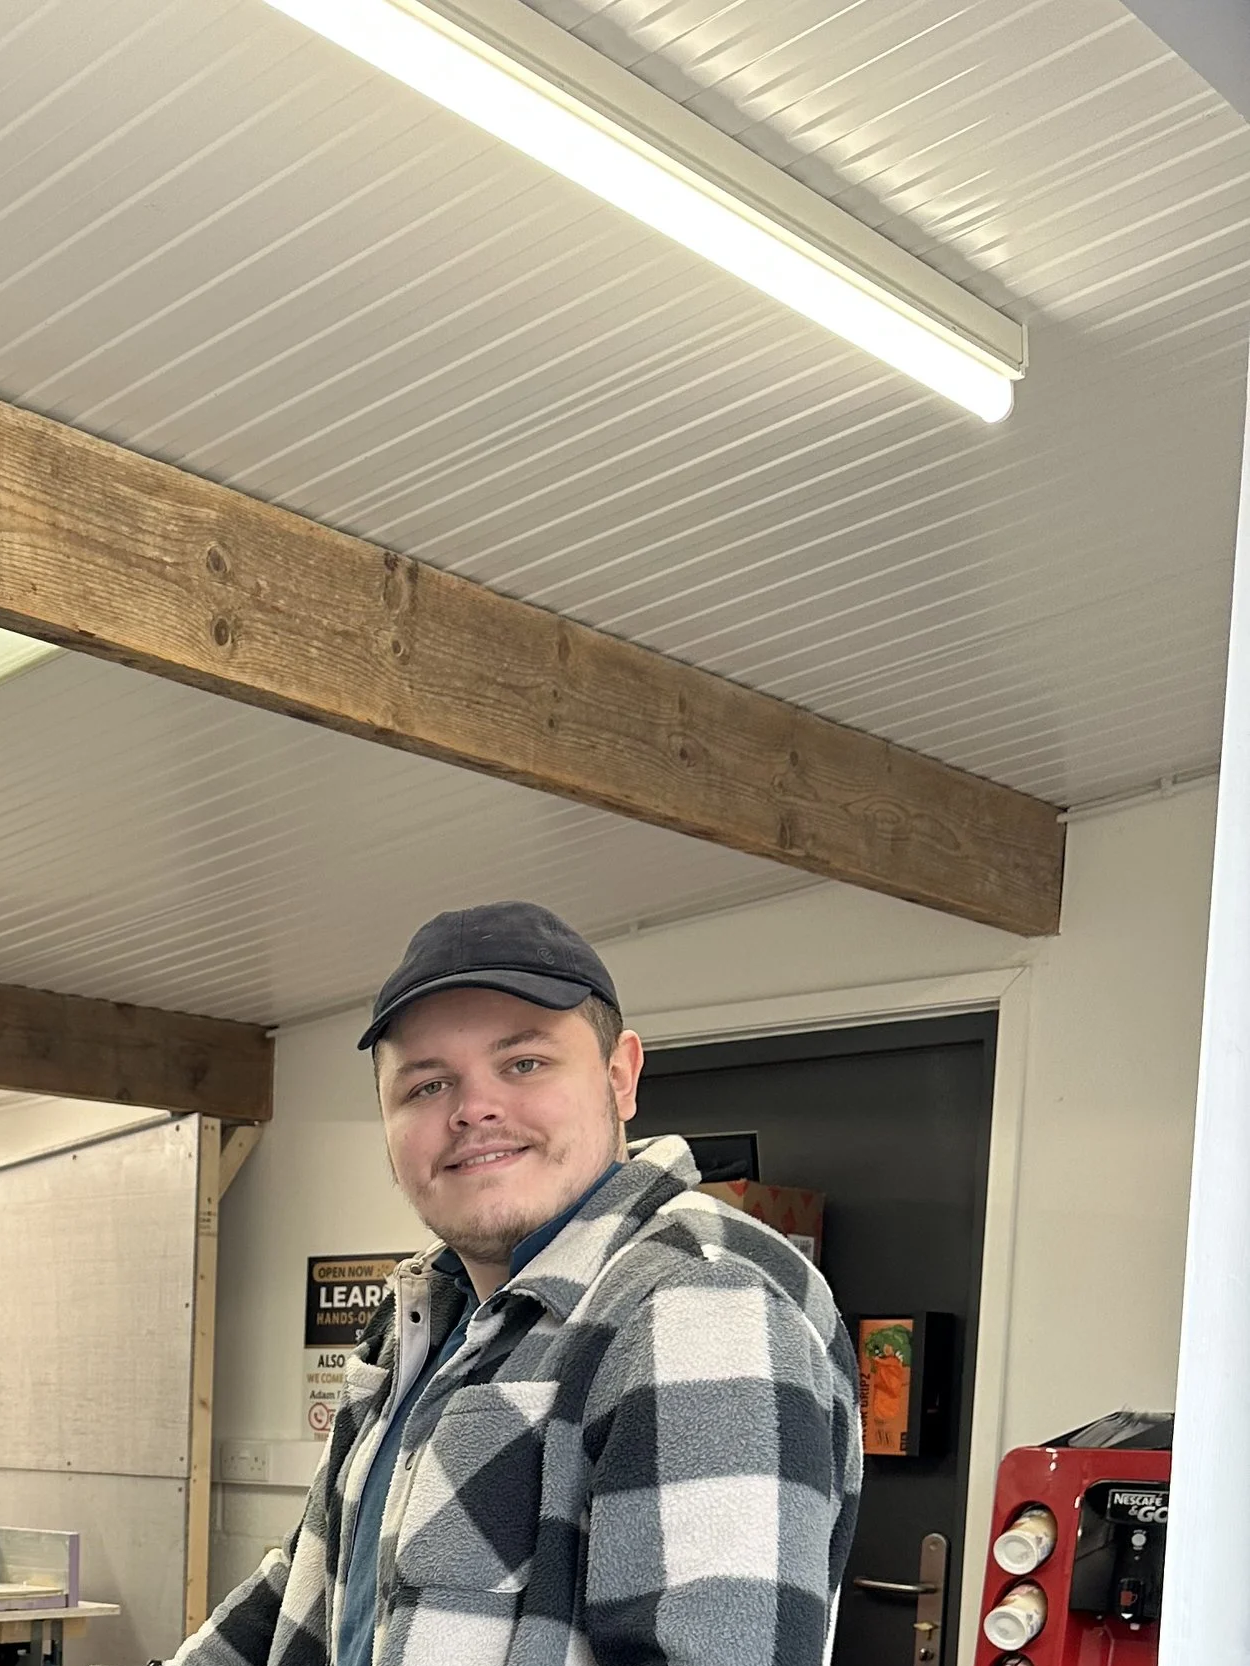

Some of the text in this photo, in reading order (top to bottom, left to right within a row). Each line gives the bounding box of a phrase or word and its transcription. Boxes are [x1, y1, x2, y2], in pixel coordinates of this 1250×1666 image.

[318, 1264, 374, 1279] OPEN NOW
[317, 1354, 346, 1368] ALSO
[306, 1373, 344, 1384] WE COME
[309, 1390, 336, 1400] Adam
[1128, 1505, 1138, 1517] &
